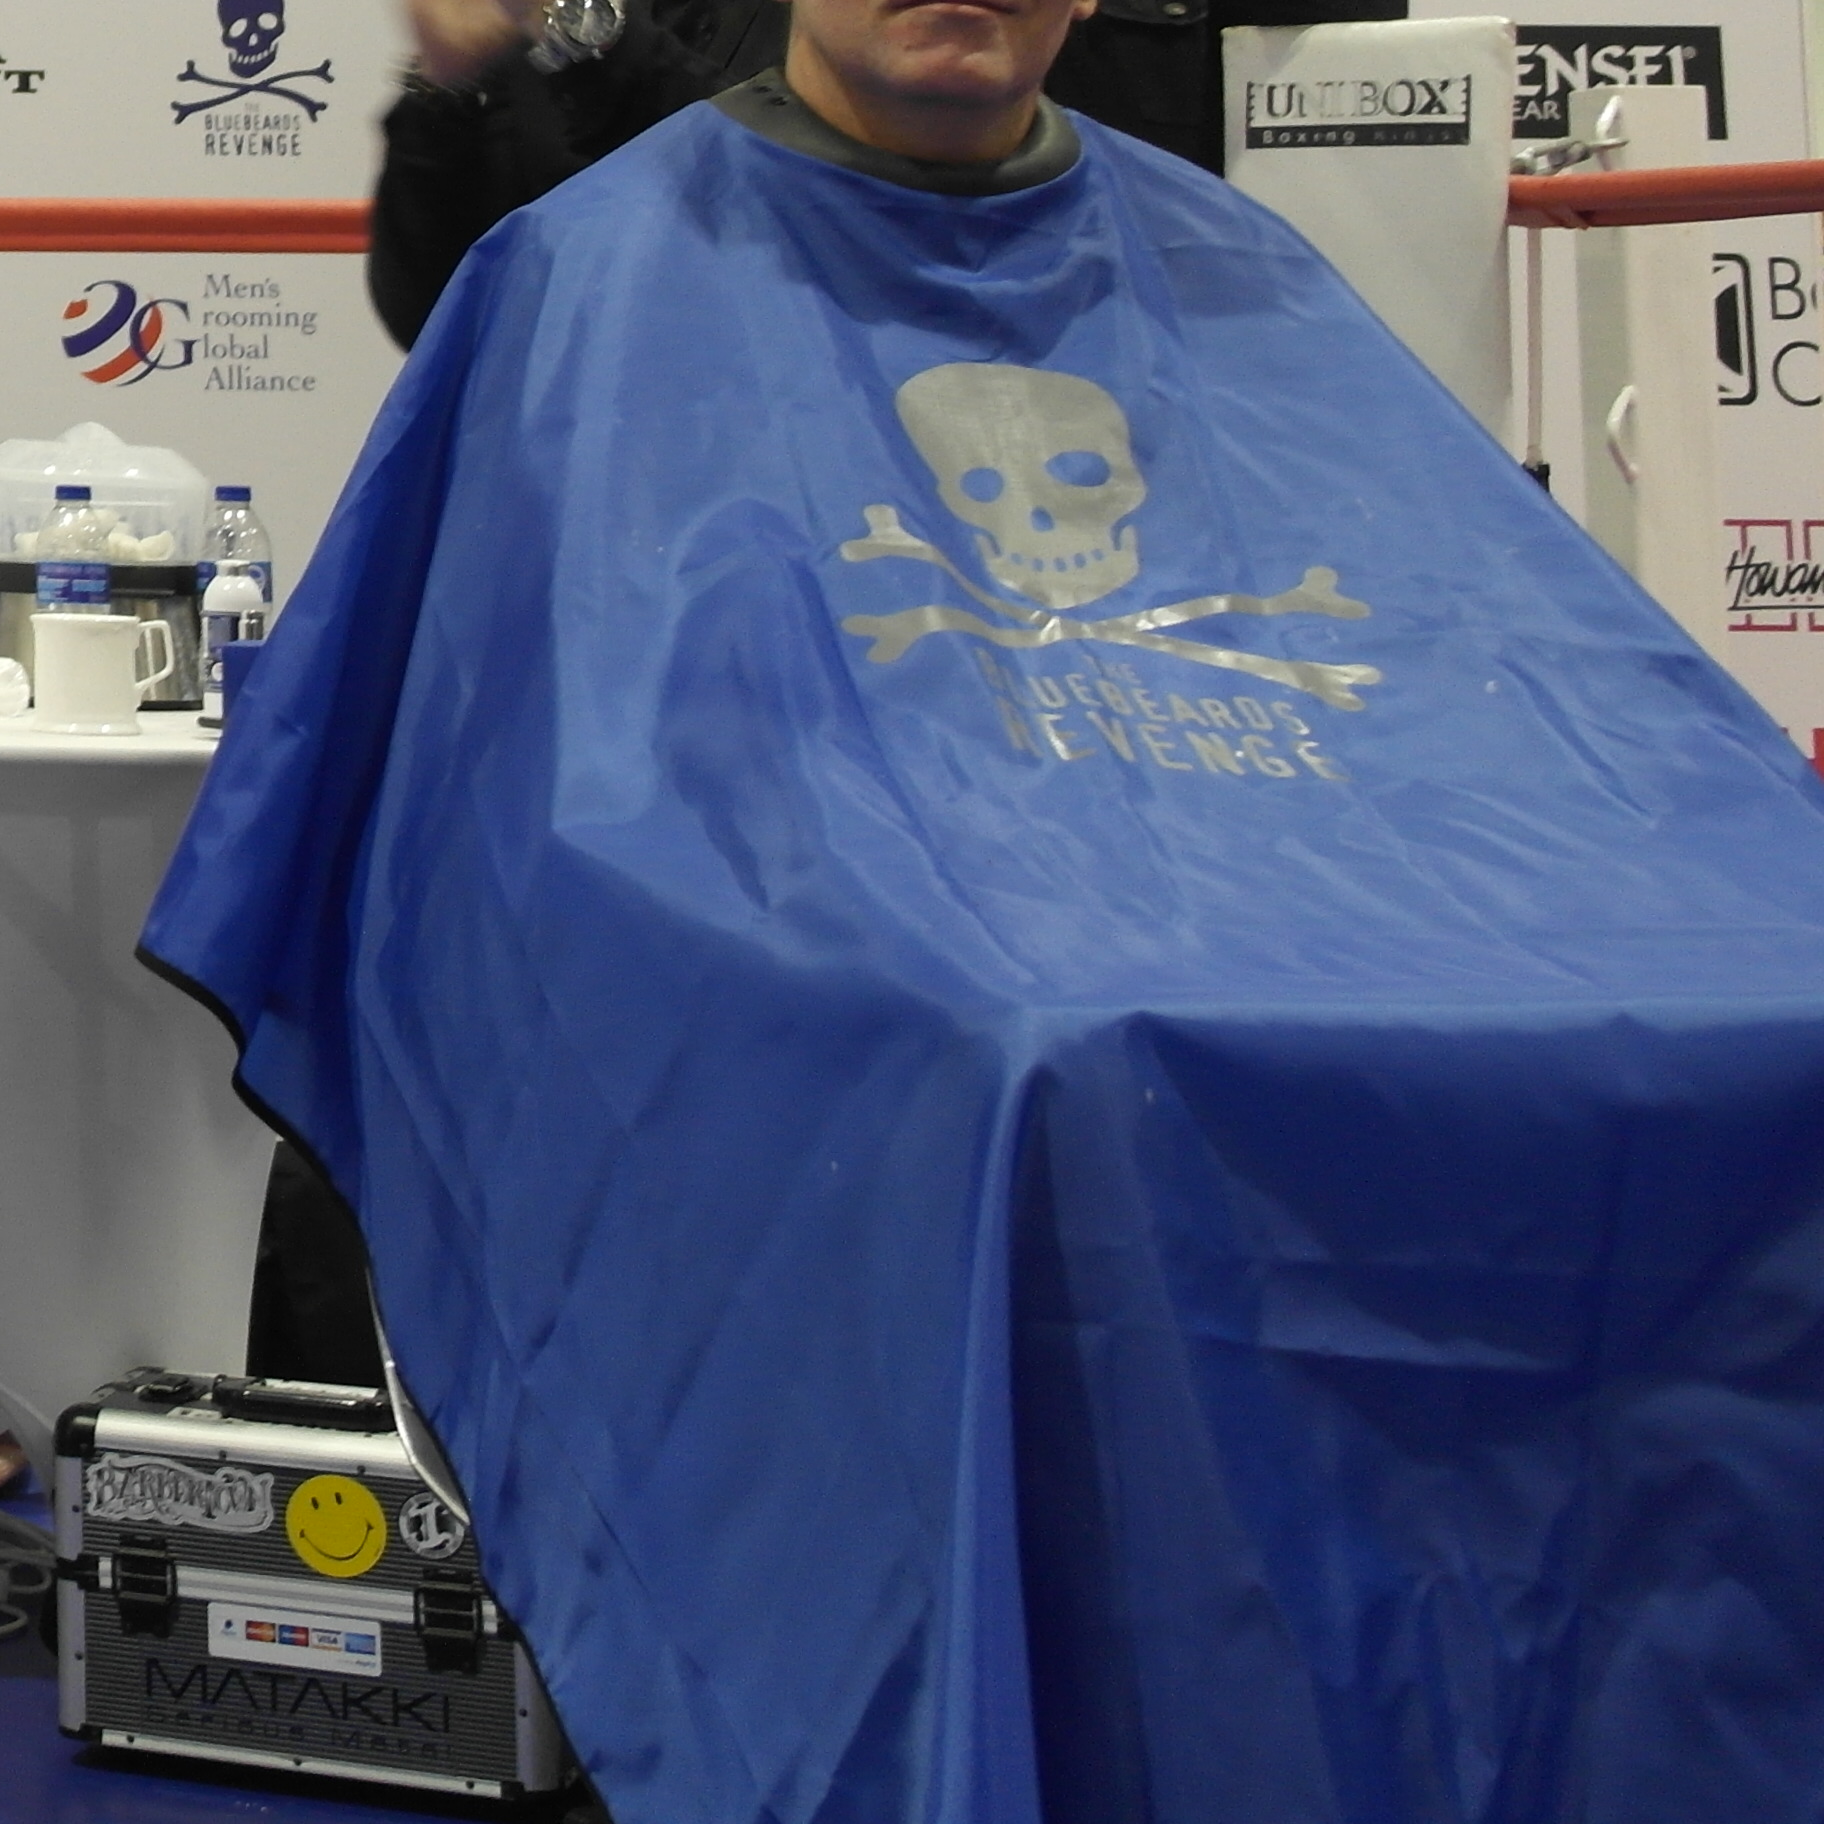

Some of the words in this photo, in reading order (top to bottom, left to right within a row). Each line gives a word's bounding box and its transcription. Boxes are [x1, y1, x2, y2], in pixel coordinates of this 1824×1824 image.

[204, 114, 302, 131] BLUEBEARDS
[204, 135, 302, 157] REVENGE
[203, 274, 280, 299] Men's
[203, 366, 317, 392] Alliance
[145, 1658, 450, 1733] MATAKKI
